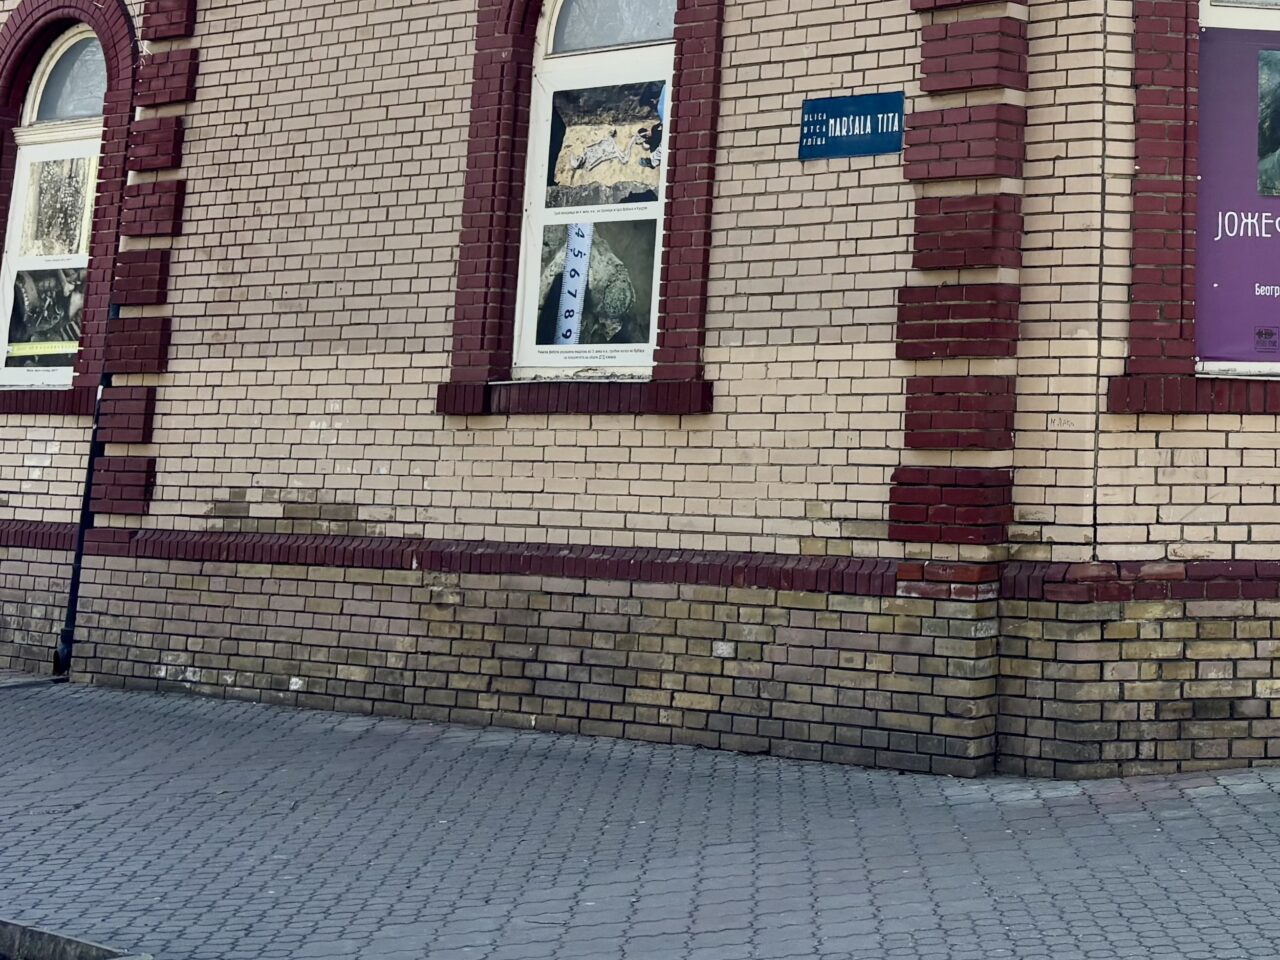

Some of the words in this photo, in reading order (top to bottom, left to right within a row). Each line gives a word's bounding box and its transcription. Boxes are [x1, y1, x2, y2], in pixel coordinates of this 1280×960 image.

[804, 113, 826, 121] ULICA
[877, 113, 898, 132] TITA
[803, 125, 826, 133] UTCA
[575, 228, 585, 238] 4
[573, 249, 583, 258] 5
[570, 268, 580, 278] 6
[567, 289, 577, 299] 7
[564, 309, 574, 319] 8
[562, 329, 572, 339] 9
